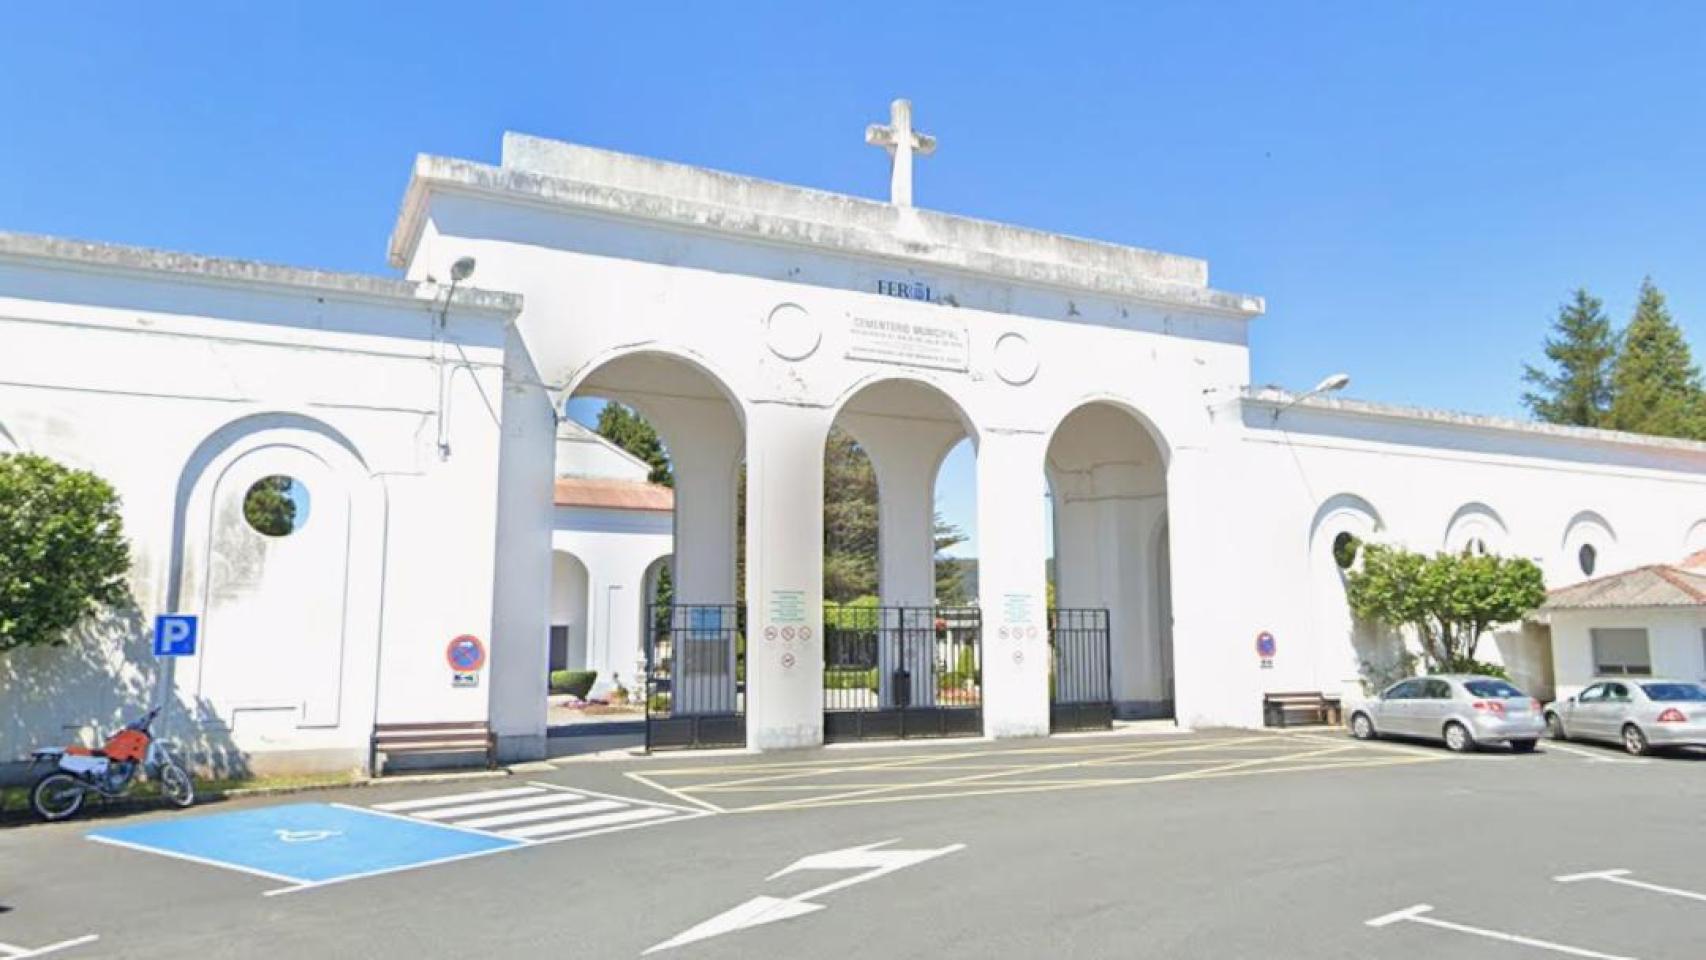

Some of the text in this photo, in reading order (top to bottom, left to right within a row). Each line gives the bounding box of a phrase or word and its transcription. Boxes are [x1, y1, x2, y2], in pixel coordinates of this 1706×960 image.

[853, 317, 911, 334] CEMENTERIO
[912, 325, 960, 341] MUNICIPAL
[161, 619, 190, 651] P
